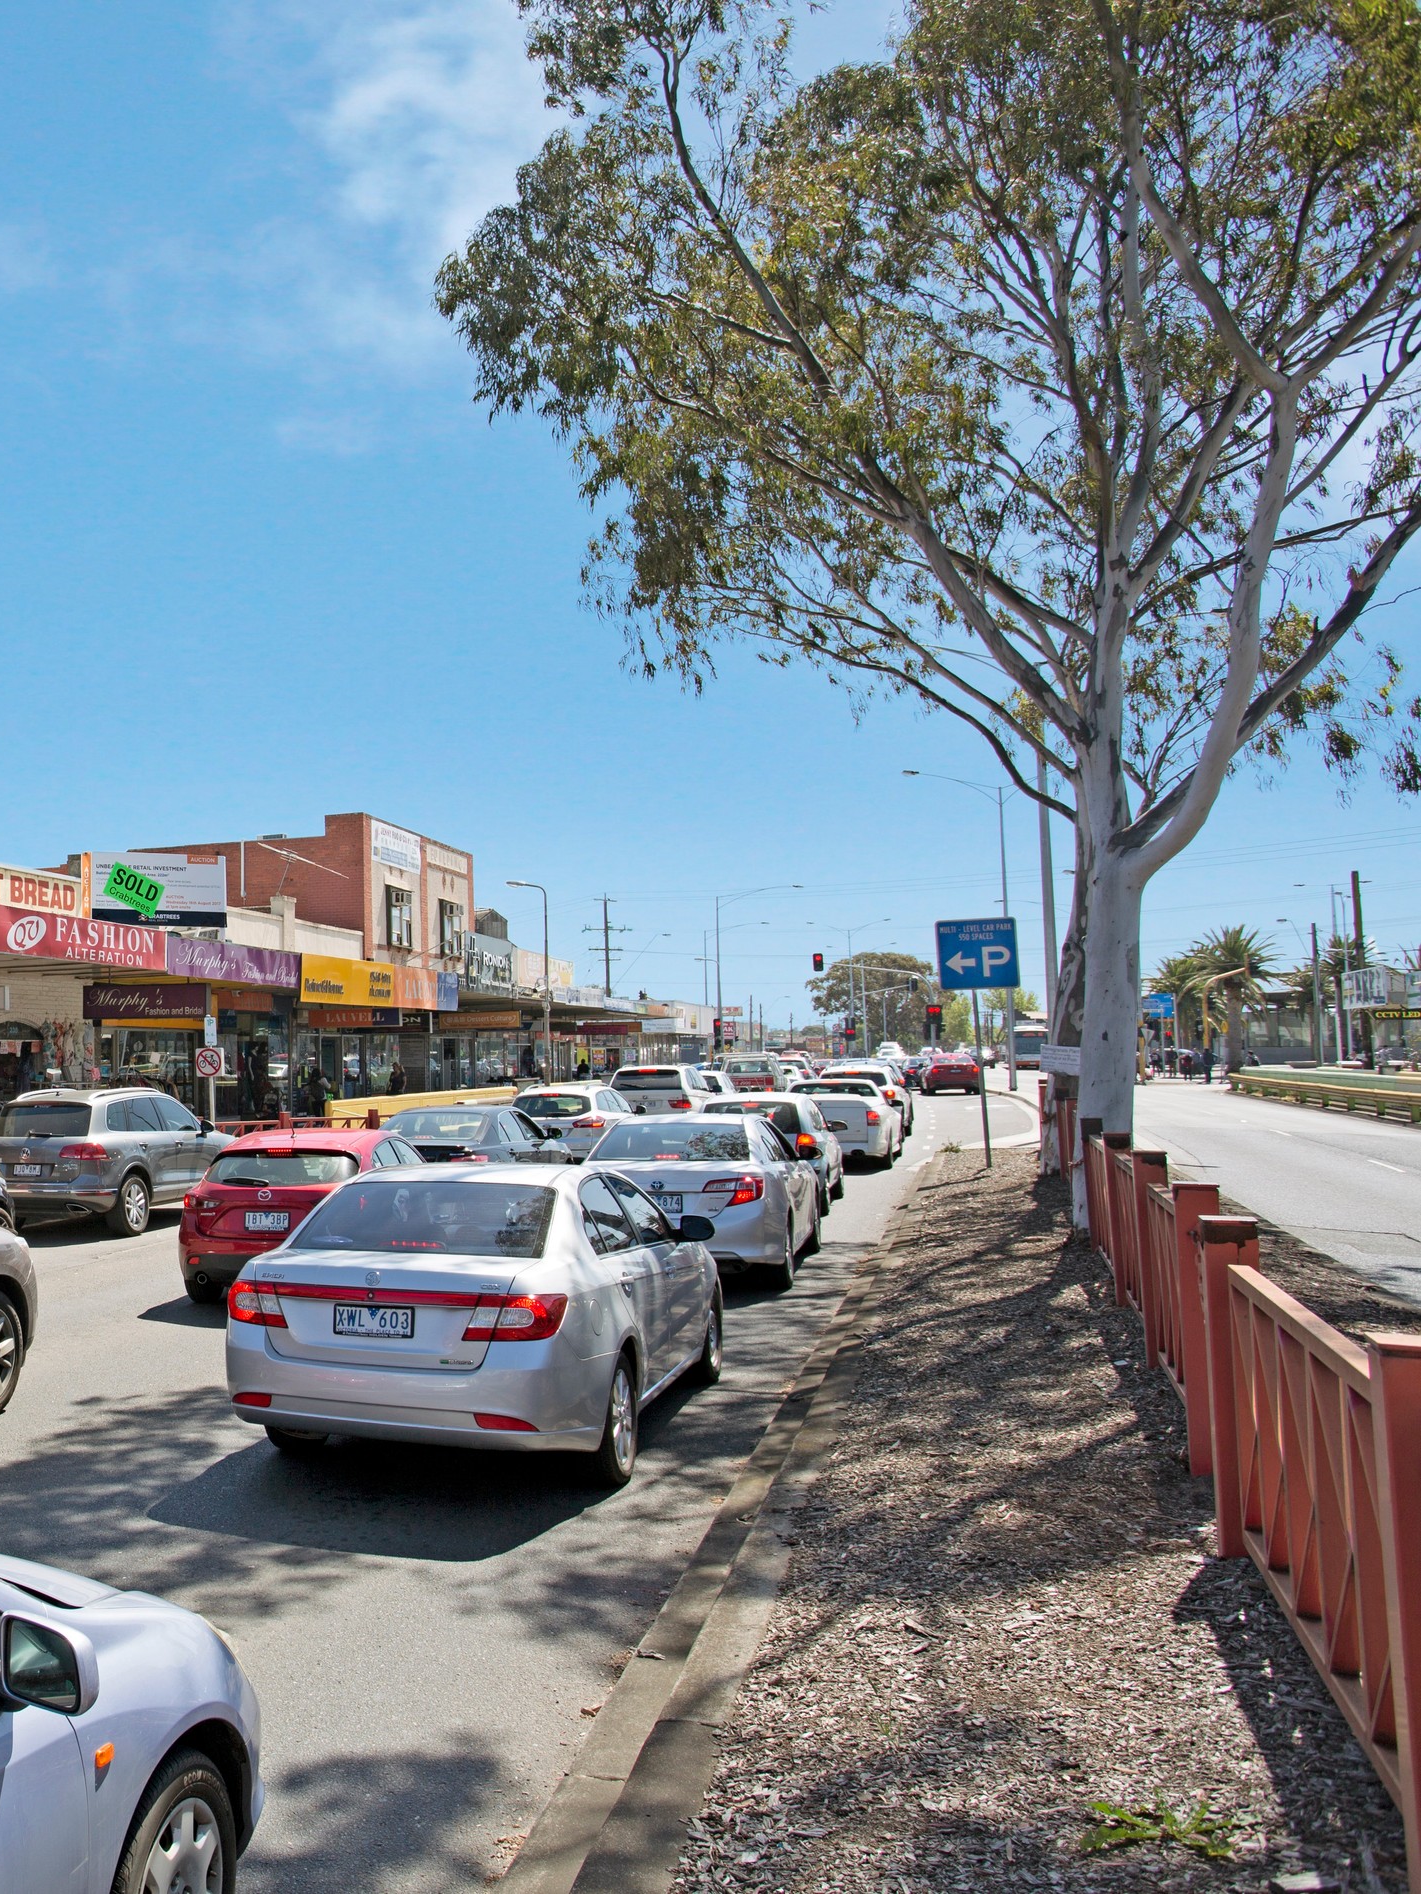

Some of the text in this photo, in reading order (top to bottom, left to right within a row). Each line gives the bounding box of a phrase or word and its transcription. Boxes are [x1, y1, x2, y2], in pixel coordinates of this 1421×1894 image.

[10, 872, 76, 912] BREAD
[113, 869, 158, 902] SOLD
[109, 886, 150, 913] Crabtrees
[55, 917, 155, 954] FASHION
[66, 946, 143, 966] ALTERATION
[176, 943, 237, 977] Murphy's
[982, 945, 1010, 977] P
[145, 1006, 204, 1016] Fashion and Bridal
[325, 1011, 384, 1022] LAUVELL
[270, 1214, 288, 1225] 3BP
[337, 1309, 409, 1331] XWL 603
